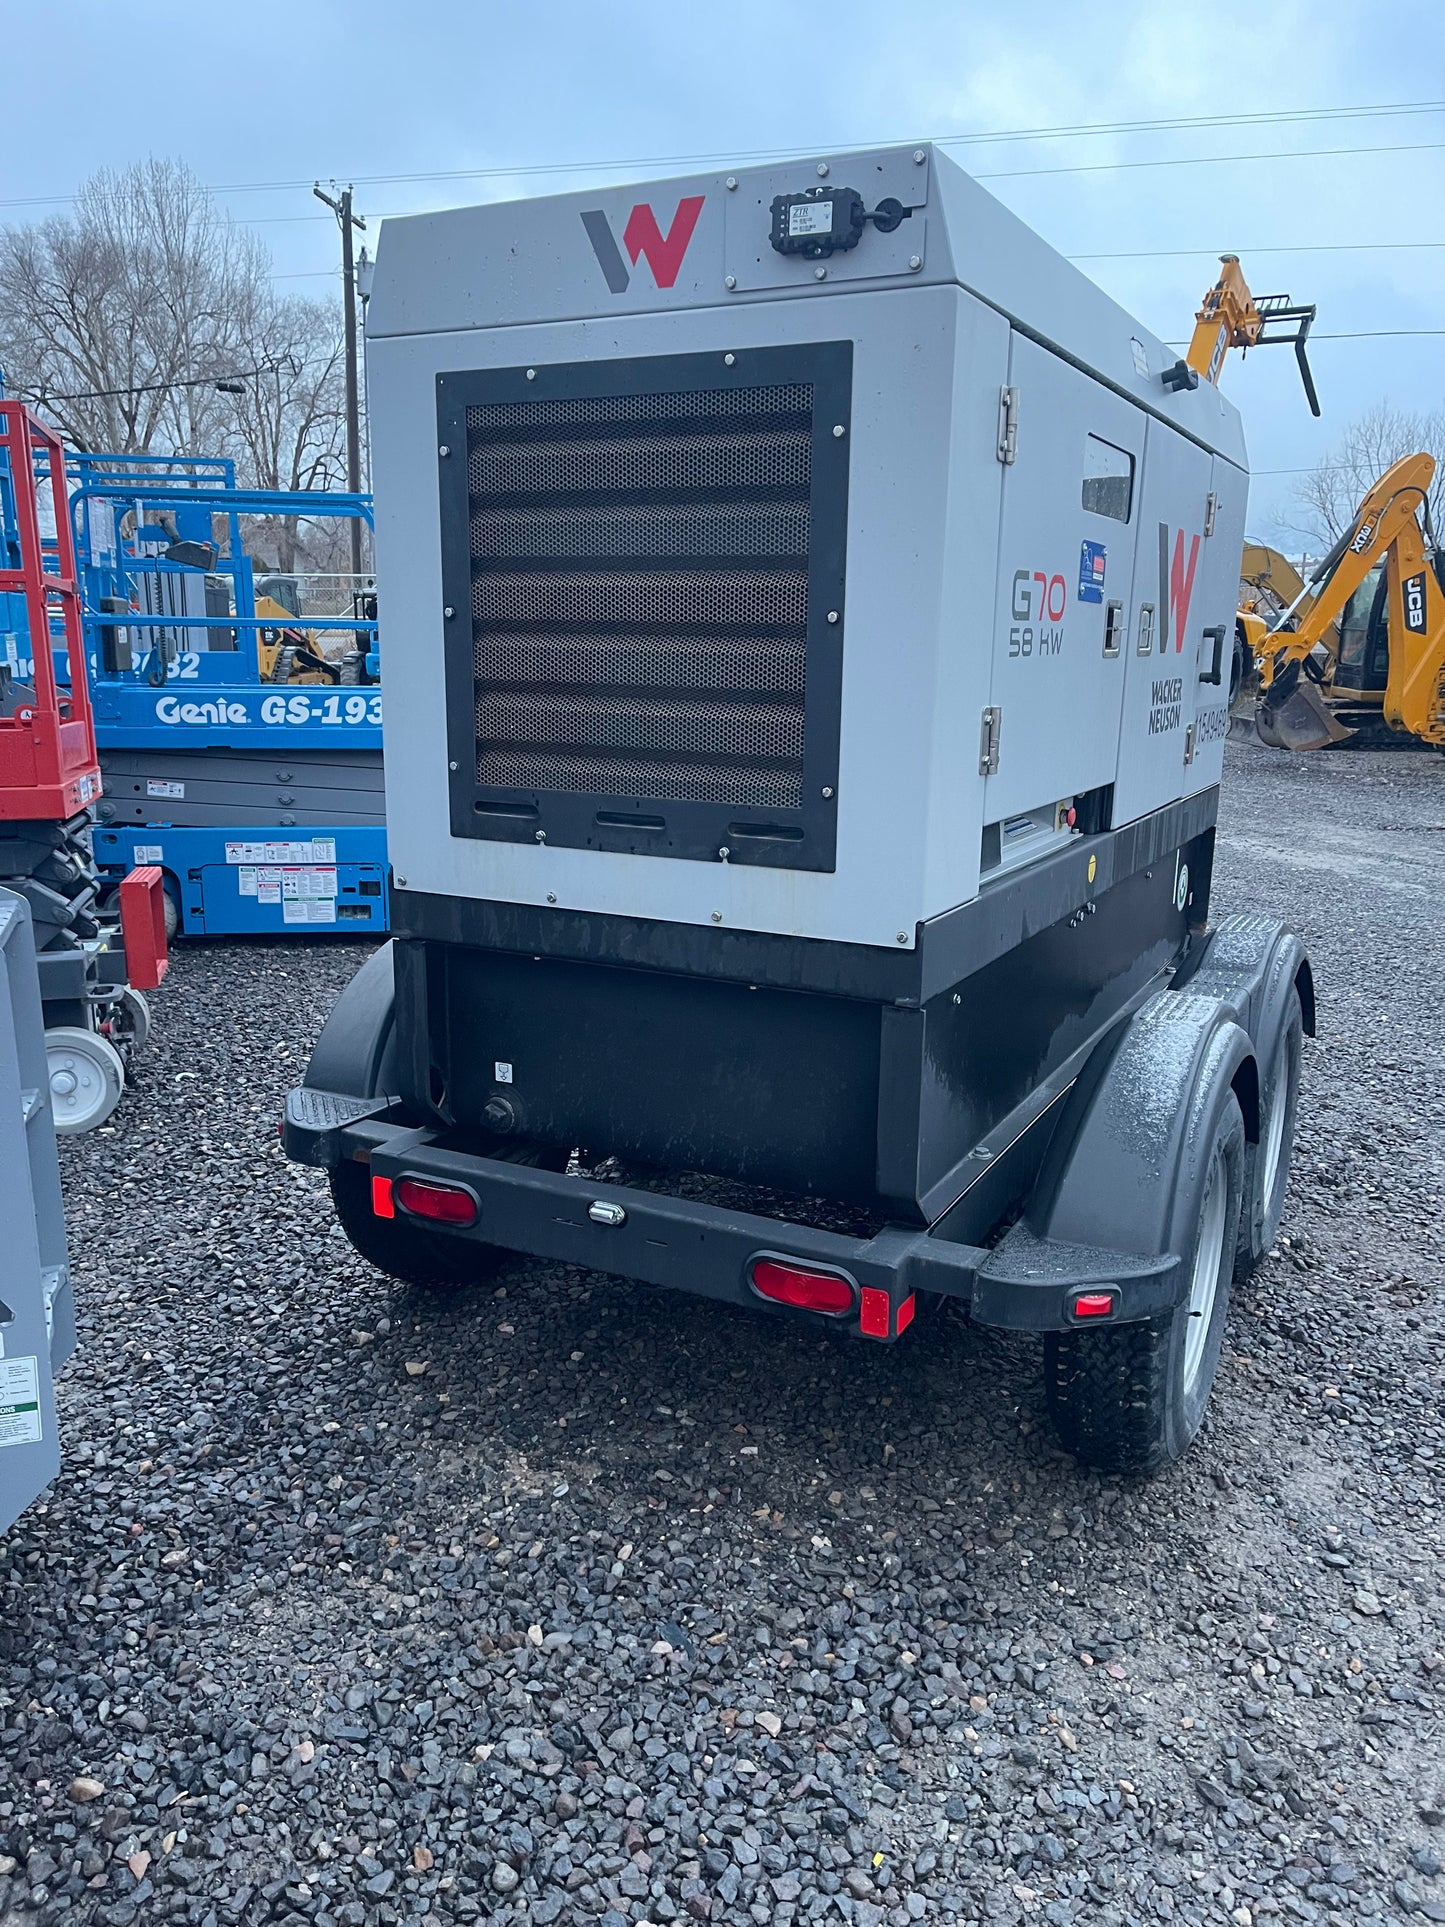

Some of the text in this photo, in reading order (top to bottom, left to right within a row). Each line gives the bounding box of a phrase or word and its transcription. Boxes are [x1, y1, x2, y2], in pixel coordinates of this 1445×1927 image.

[1350, 525, 1372, 554] 3CX
[1012, 569, 1066, 622] G70
[1407, 578, 1424, 628] JCB
[1009, 627, 1033, 657] 58
[1151, 678, 1183, 706] WACKER
[155, 696, 247, 725] Genie
[1148, 704, 1182, 736] NEUSON
